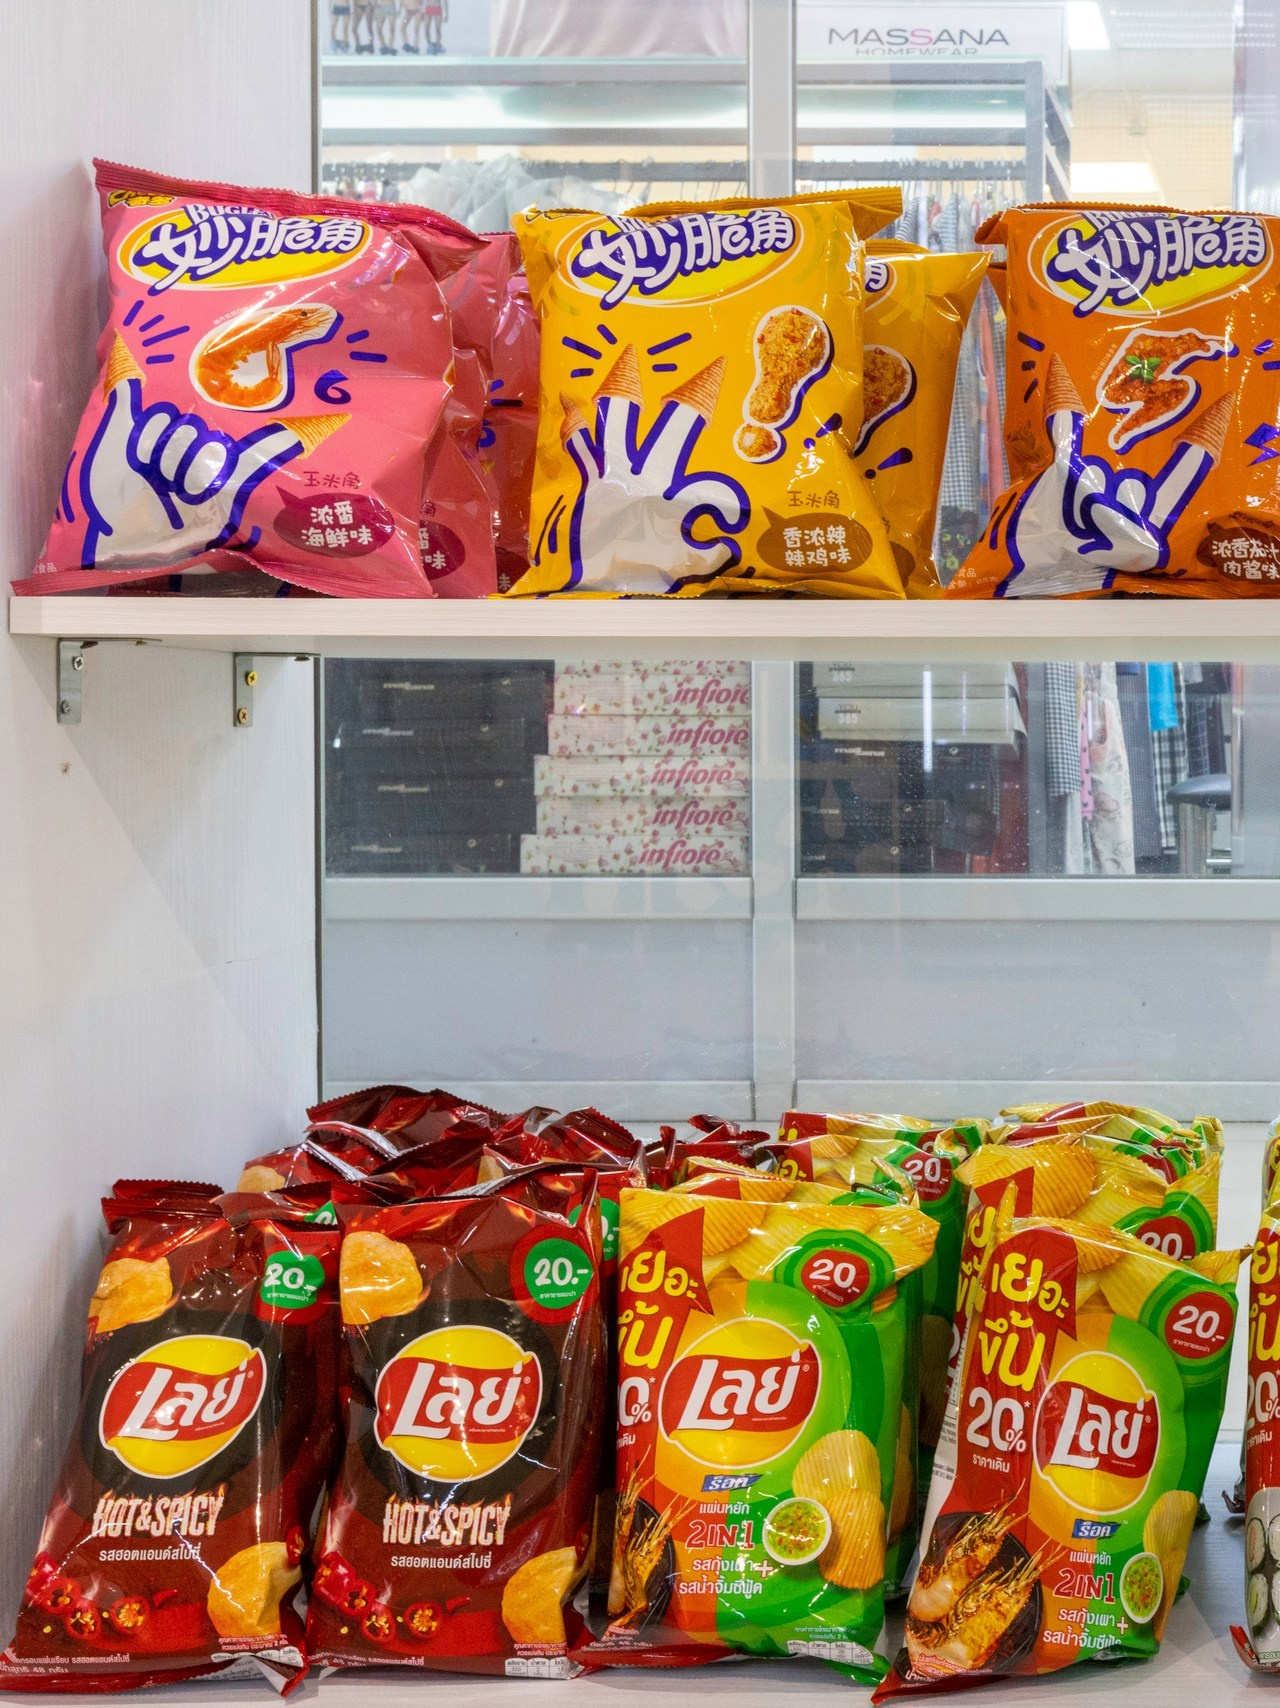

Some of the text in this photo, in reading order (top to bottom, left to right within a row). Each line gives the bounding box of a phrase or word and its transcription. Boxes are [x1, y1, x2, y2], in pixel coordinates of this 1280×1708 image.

[828, 28, 1010, 46] MASSANA
[142, 215, 364, 291] 妙脆角
[580, 209, 795, 303] 妙脆角
[1055, 217, 1266, 311] 妙脆角
[303, 470, 361, 490] 玉米角
[787, 490, 840, 509] 玉米角
[301, 524, 374, 549] 海鲜味
[783, 525, 846, 549] 香浓辣
[785, 546, 852, 567] 辣鸡味
[1223, 560, 1280, 580] 肉酱味
[666, 719, 749, 749] infiore
[650, 759, 736, 789] infiore
[652, 800, 737, 829] infiore
[639, 839, 725, 869] infiore
[992, 1253, 1069, 1319] เยอะ
[979, 1309, 1046, 1392] ขึ้น
[972, 1453, 1010, 1474] ราคาเดิม
[92, 1494, 224, 1539] HOT&SPICY
[700, 1500, 750, 1515] แผ่นหยัก
[382, 1500, 511, 1548] HOT&SPICY
[390, 1551, 492, 1570] รสฮอตแอนด์สไปซี่
[1070, 1549, 1112, 1566] แผ่นหยัก
[1059, 1608, 1116, 1628] รสกุ้งเผา
